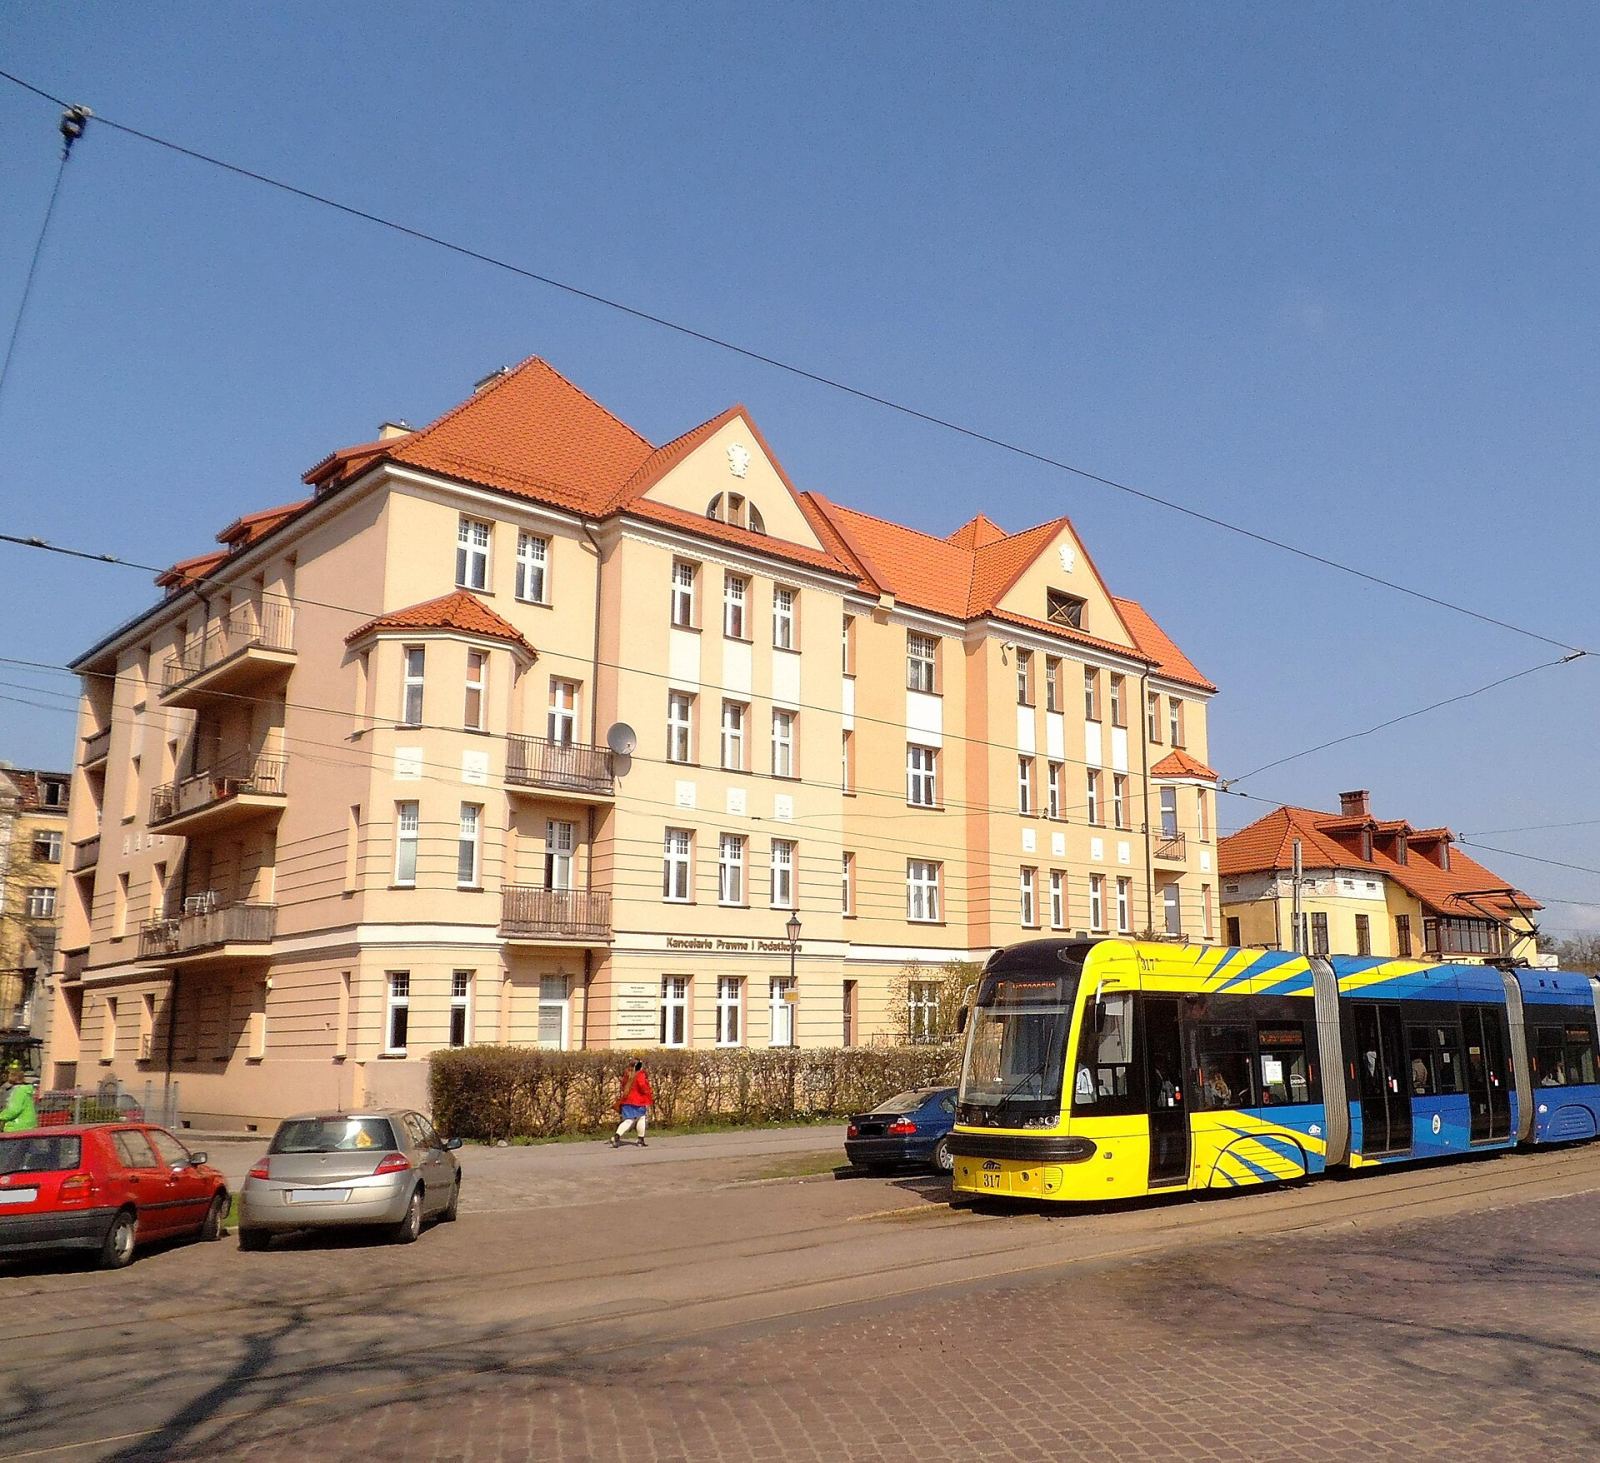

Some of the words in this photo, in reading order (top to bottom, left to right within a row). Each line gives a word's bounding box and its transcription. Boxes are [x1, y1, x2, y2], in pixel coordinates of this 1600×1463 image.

[666, 937, 713, 949] Kancelarie
[716, 939, 748, 951] Prawne
[983, 1173, 1001, 1188] 317
